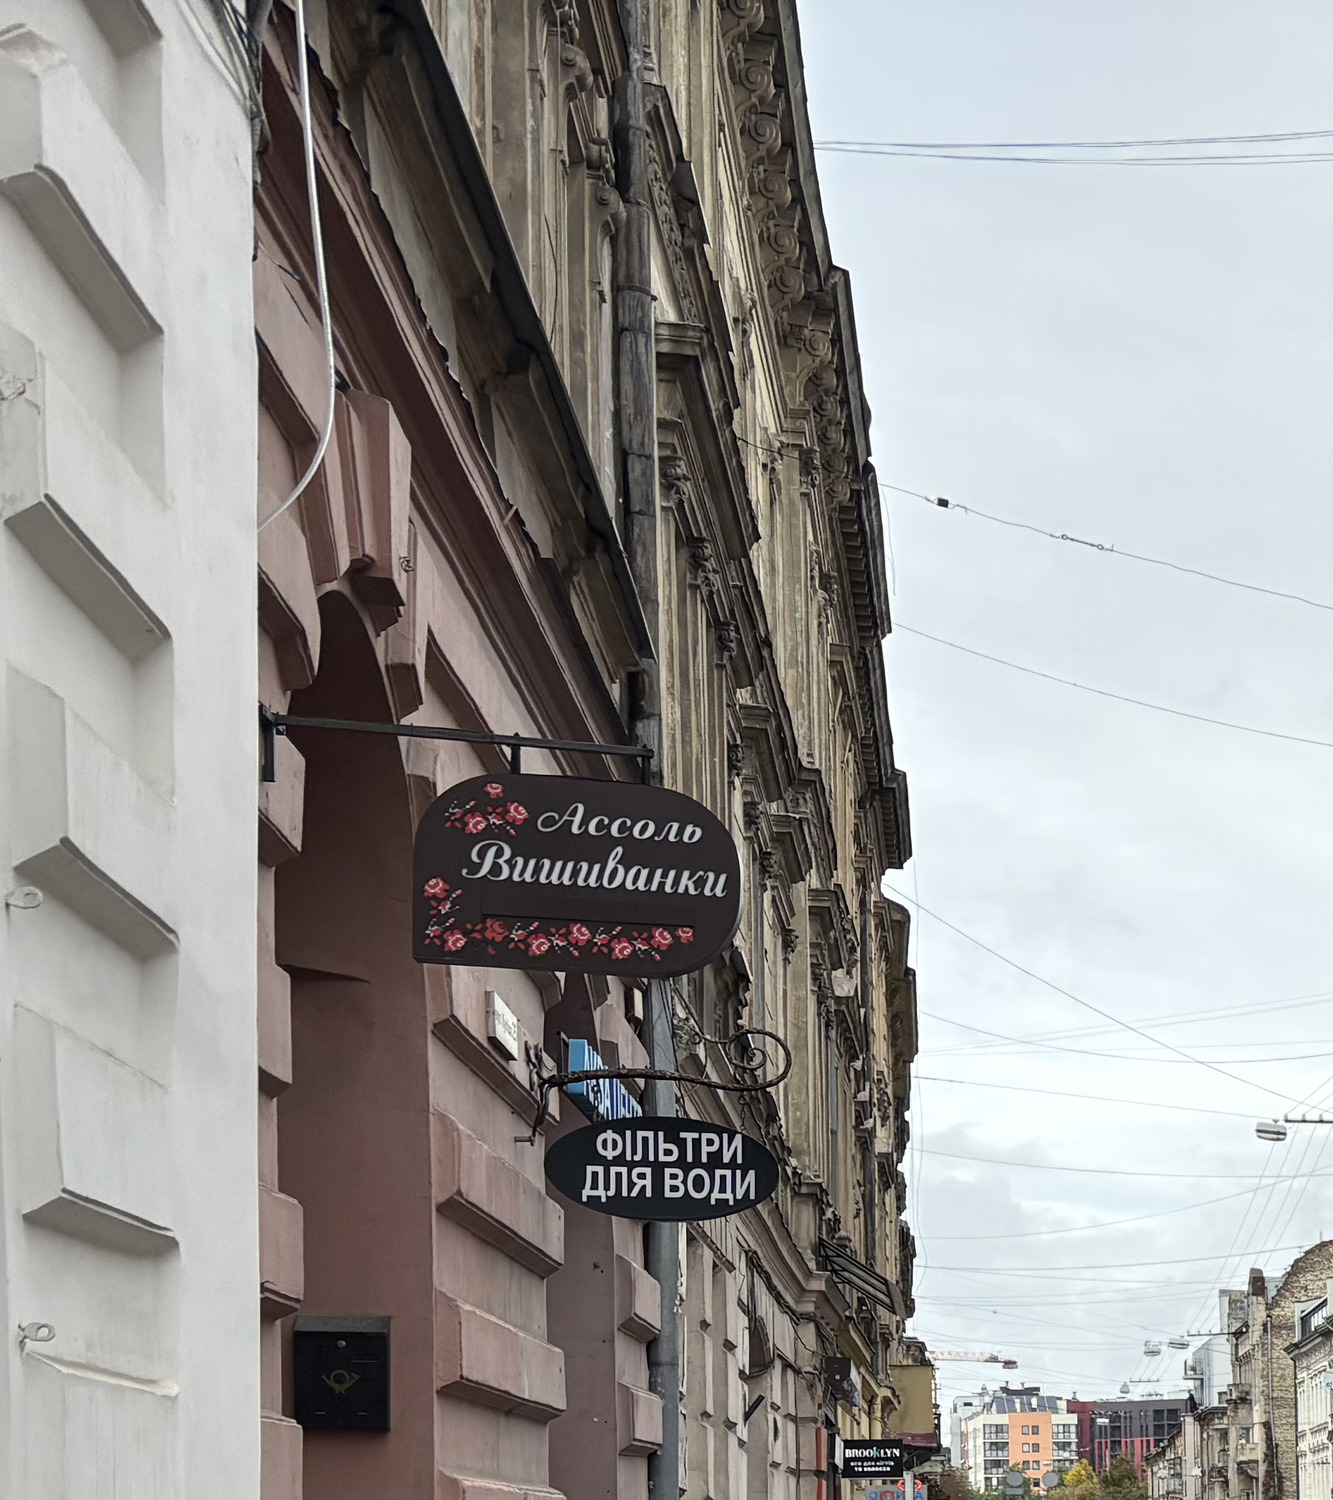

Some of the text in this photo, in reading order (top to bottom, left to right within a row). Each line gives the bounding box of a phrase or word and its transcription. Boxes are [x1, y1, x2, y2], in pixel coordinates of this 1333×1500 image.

[537, 803, 702, 844] Ассоль
[461, 840, 727, 898] Вишиванки
[596, 1129, 743, 1165] ФІЛЬТРИ
[582, 1166, 757, 1205] ДЛЯ ВОДИ
